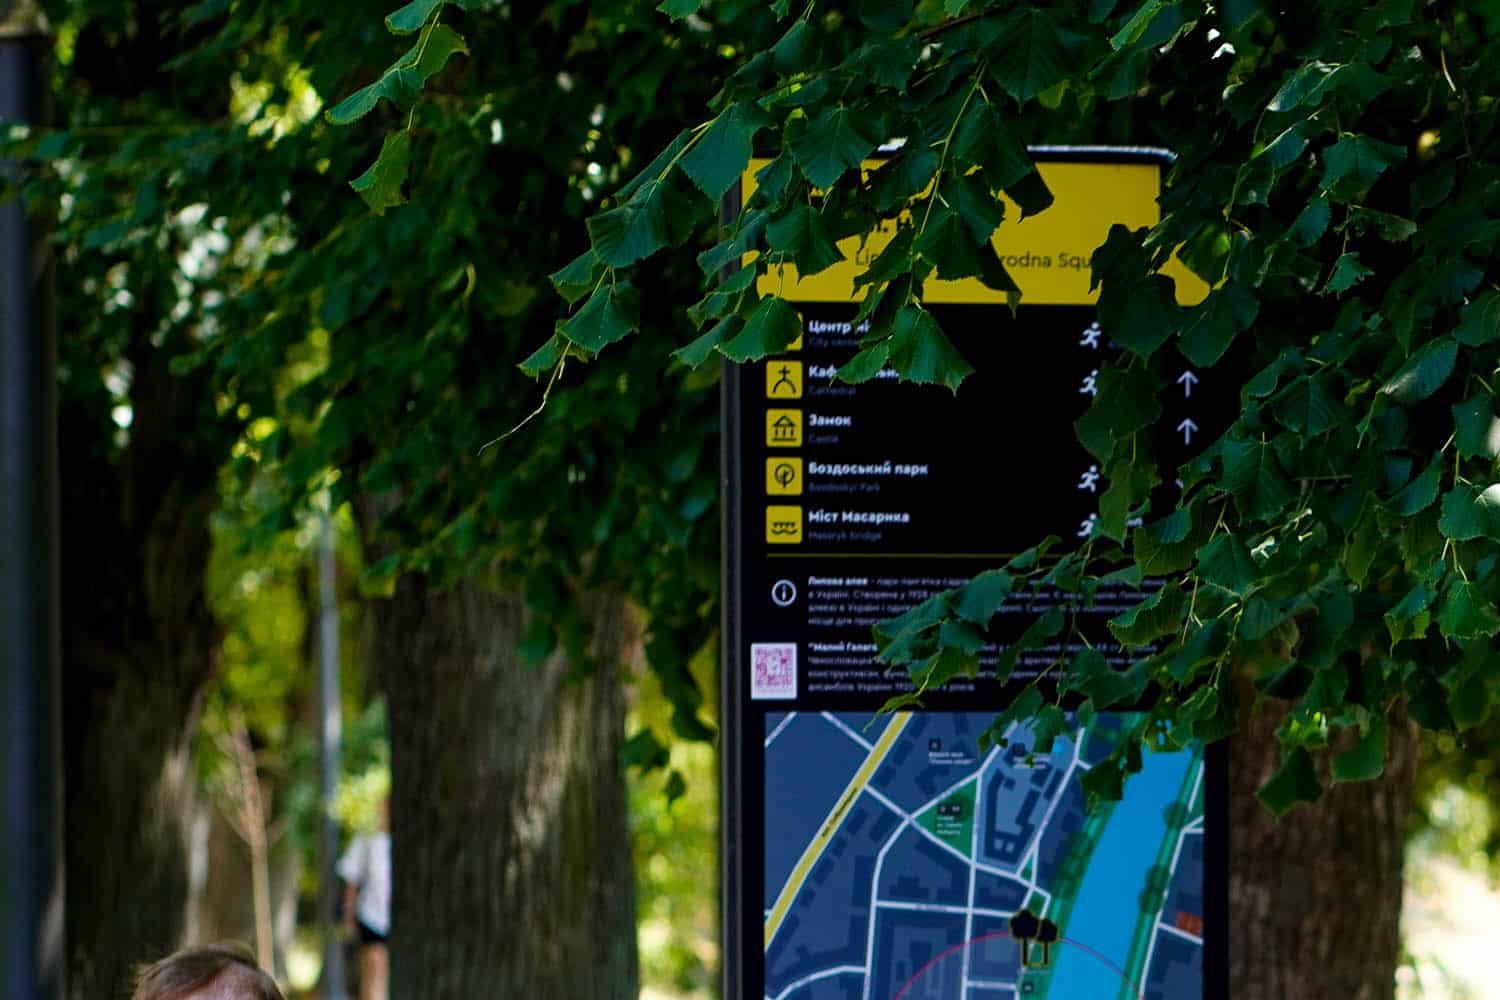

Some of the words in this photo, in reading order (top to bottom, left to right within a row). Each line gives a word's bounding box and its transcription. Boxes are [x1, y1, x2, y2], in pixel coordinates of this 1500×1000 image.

[808, 320, 852, 336] Центр
[808, 414, 852, 428] Замок
[894, 464, 929, 480] парк
[808, 508, 840, 525] Міст
[841, 511, 911, 528] Масарика
